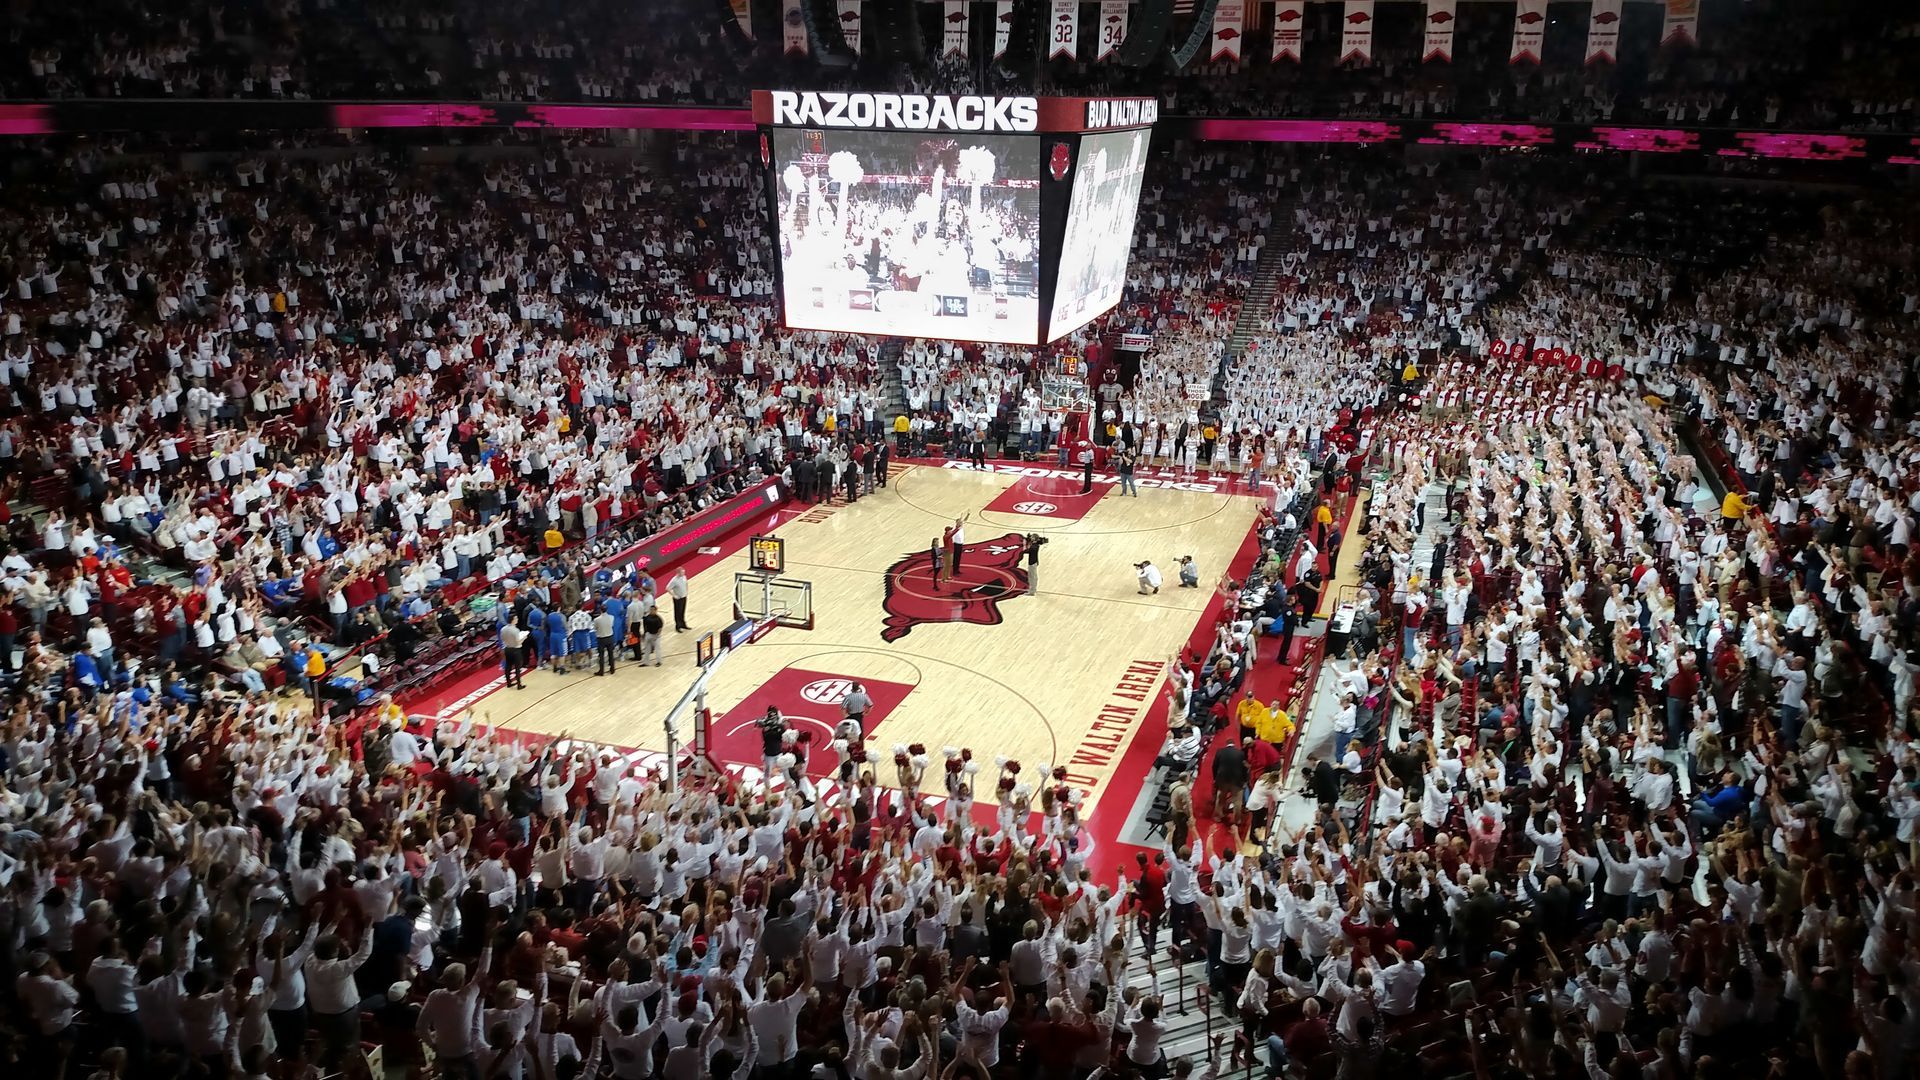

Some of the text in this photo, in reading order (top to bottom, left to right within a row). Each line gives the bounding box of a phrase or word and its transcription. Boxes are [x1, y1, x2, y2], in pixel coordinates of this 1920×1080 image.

[1055, 24, 1072, 43] 32
[1104, 25, 1123, 44] 34
[771, 91, 1038, 131] RAZORBACKS
[1088, 99, 1158, 128] BUD WALTON ARENA
[1124, 337, 1152, 346] ESPN
[1069, 363, 1075, 374] 6
[1014, 502, 1057, 514] SEC
[1112, 660, 1166, 702] ARENA
[1069, 703, 1139, 767] WALTON
